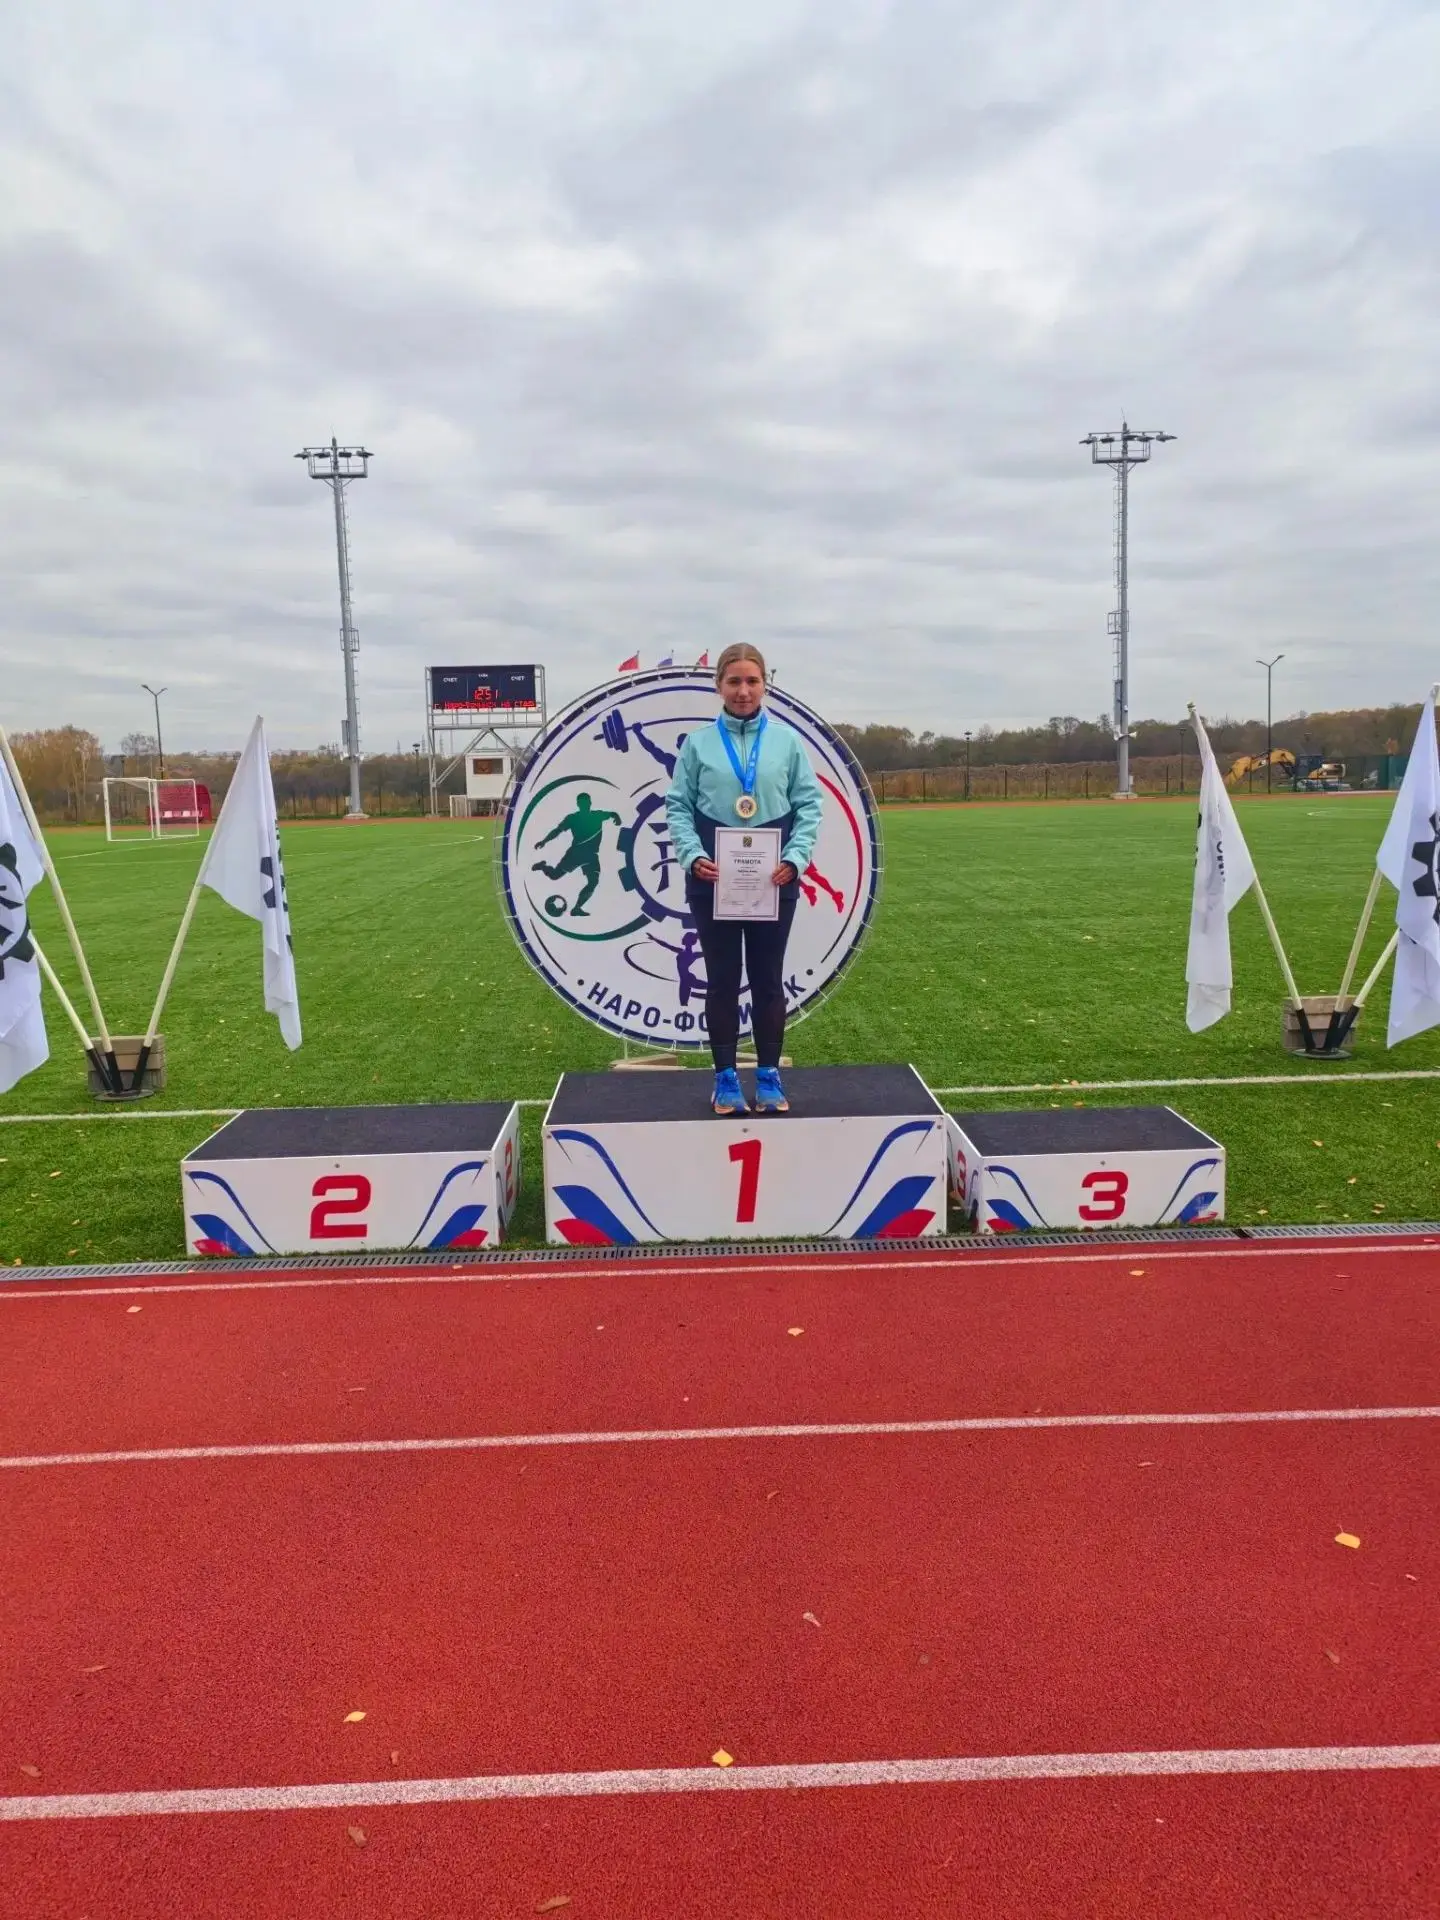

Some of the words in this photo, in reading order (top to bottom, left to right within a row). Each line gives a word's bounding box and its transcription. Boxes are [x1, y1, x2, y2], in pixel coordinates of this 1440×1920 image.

[310, 1174, 372, 1239] 2
[728, 1139, 762, 1222] 1
[1078, 1171, 1129, 1221] 3
